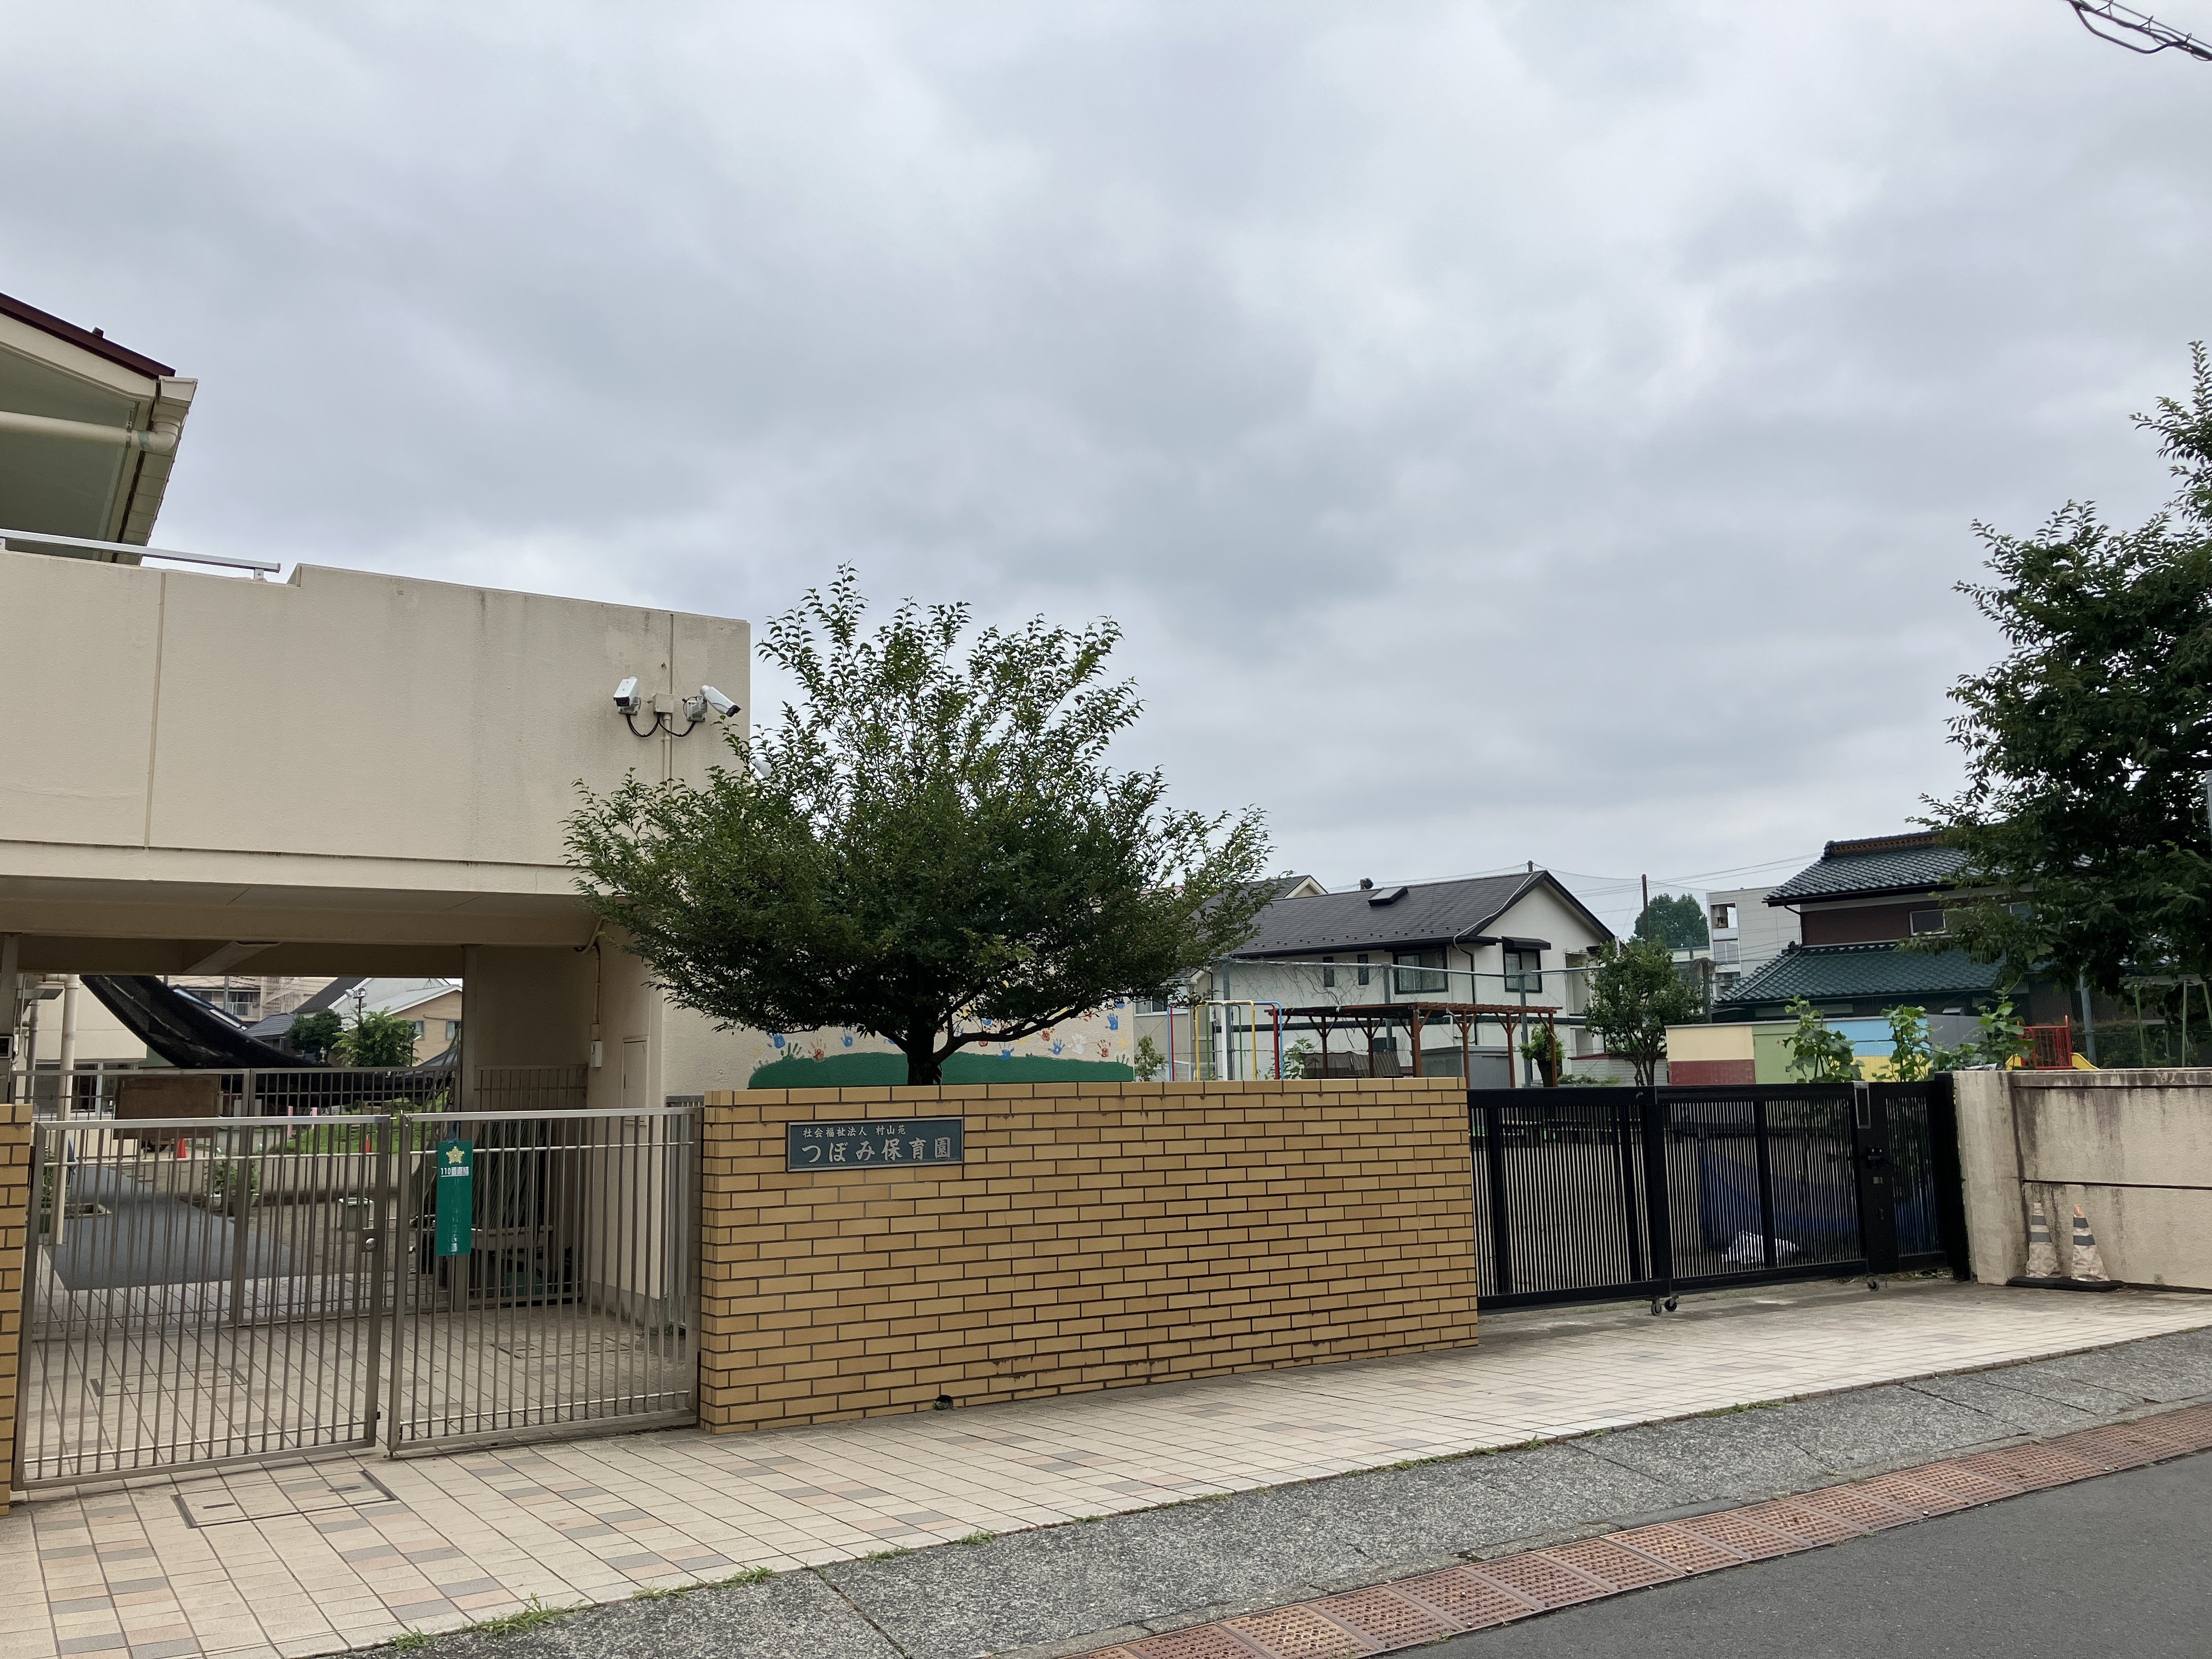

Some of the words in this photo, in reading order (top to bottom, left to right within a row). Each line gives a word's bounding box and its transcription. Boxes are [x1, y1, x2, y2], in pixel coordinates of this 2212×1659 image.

[803, 1126, 867, 1138] 社会福祉法人
[876, 1125, 906, 1136] 村山苑
[802, 1136, 951, 1164] つぼみ保育園
[441, 1166, 469, 1175] 110番直結
